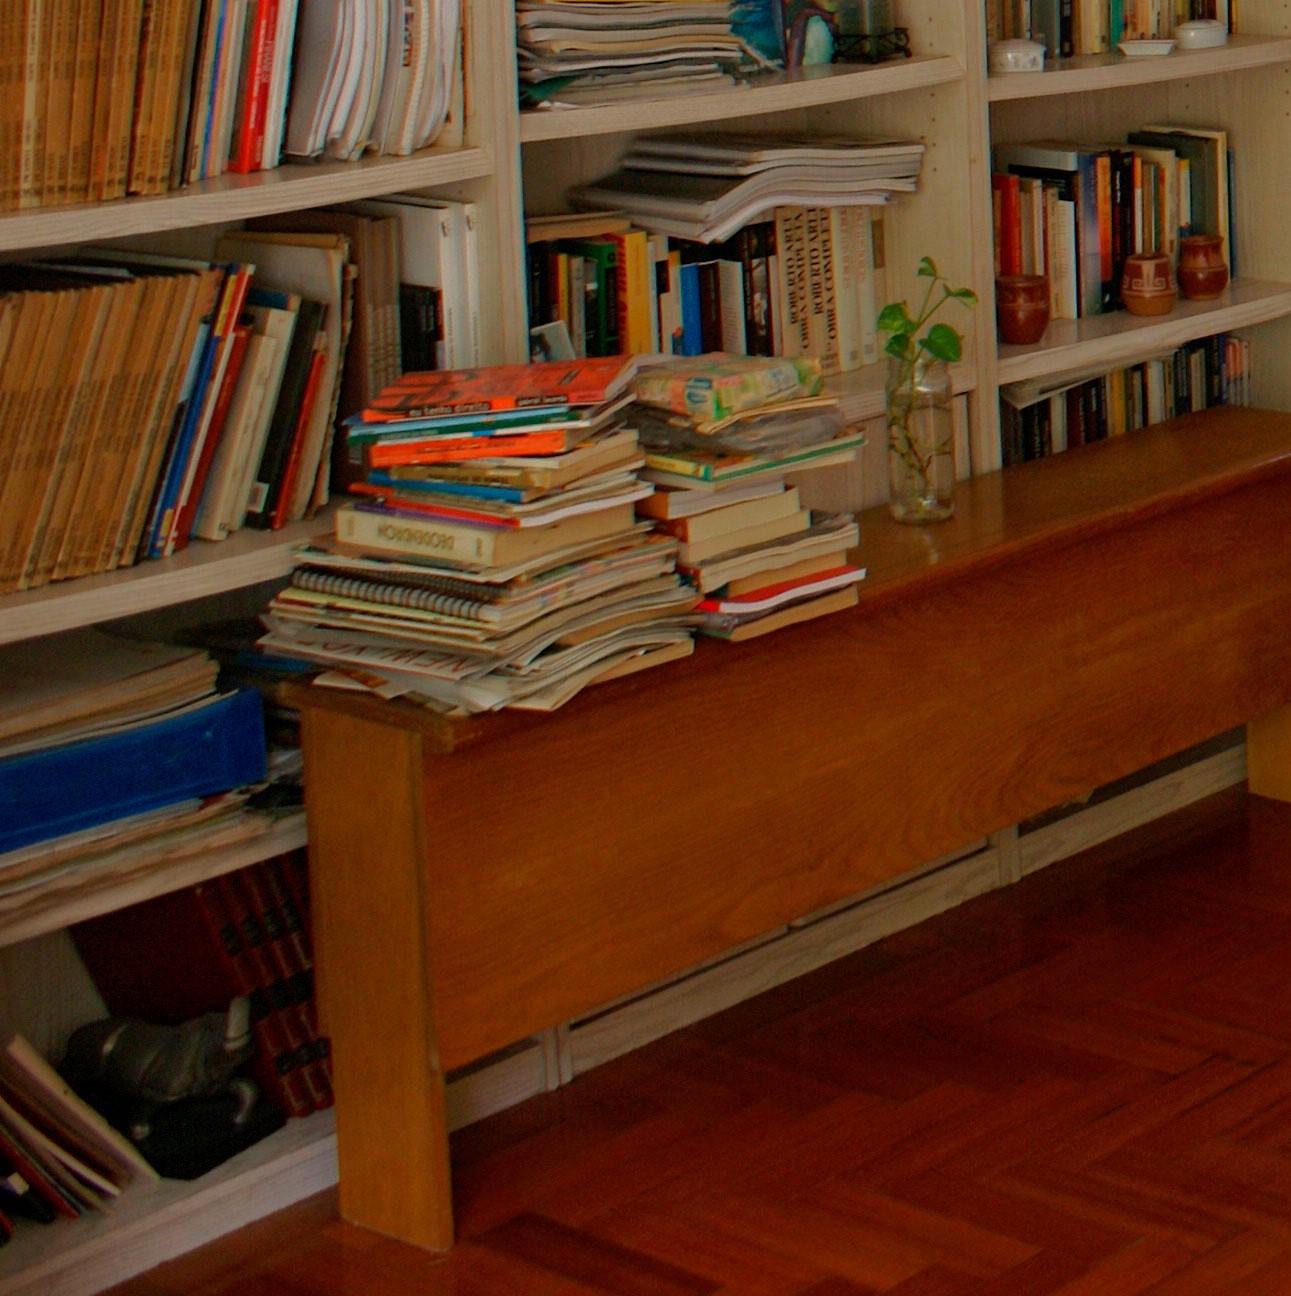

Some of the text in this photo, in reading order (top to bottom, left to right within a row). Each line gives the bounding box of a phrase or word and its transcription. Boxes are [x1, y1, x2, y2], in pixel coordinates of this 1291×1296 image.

[783, 217, 799, 325] ROBERTO ARLT
[794, 212, 809, 349] OBRA COMPLETA
[809, 247, 824, 315] ROBERTO
[826, 295, 836, 340] OBRA
